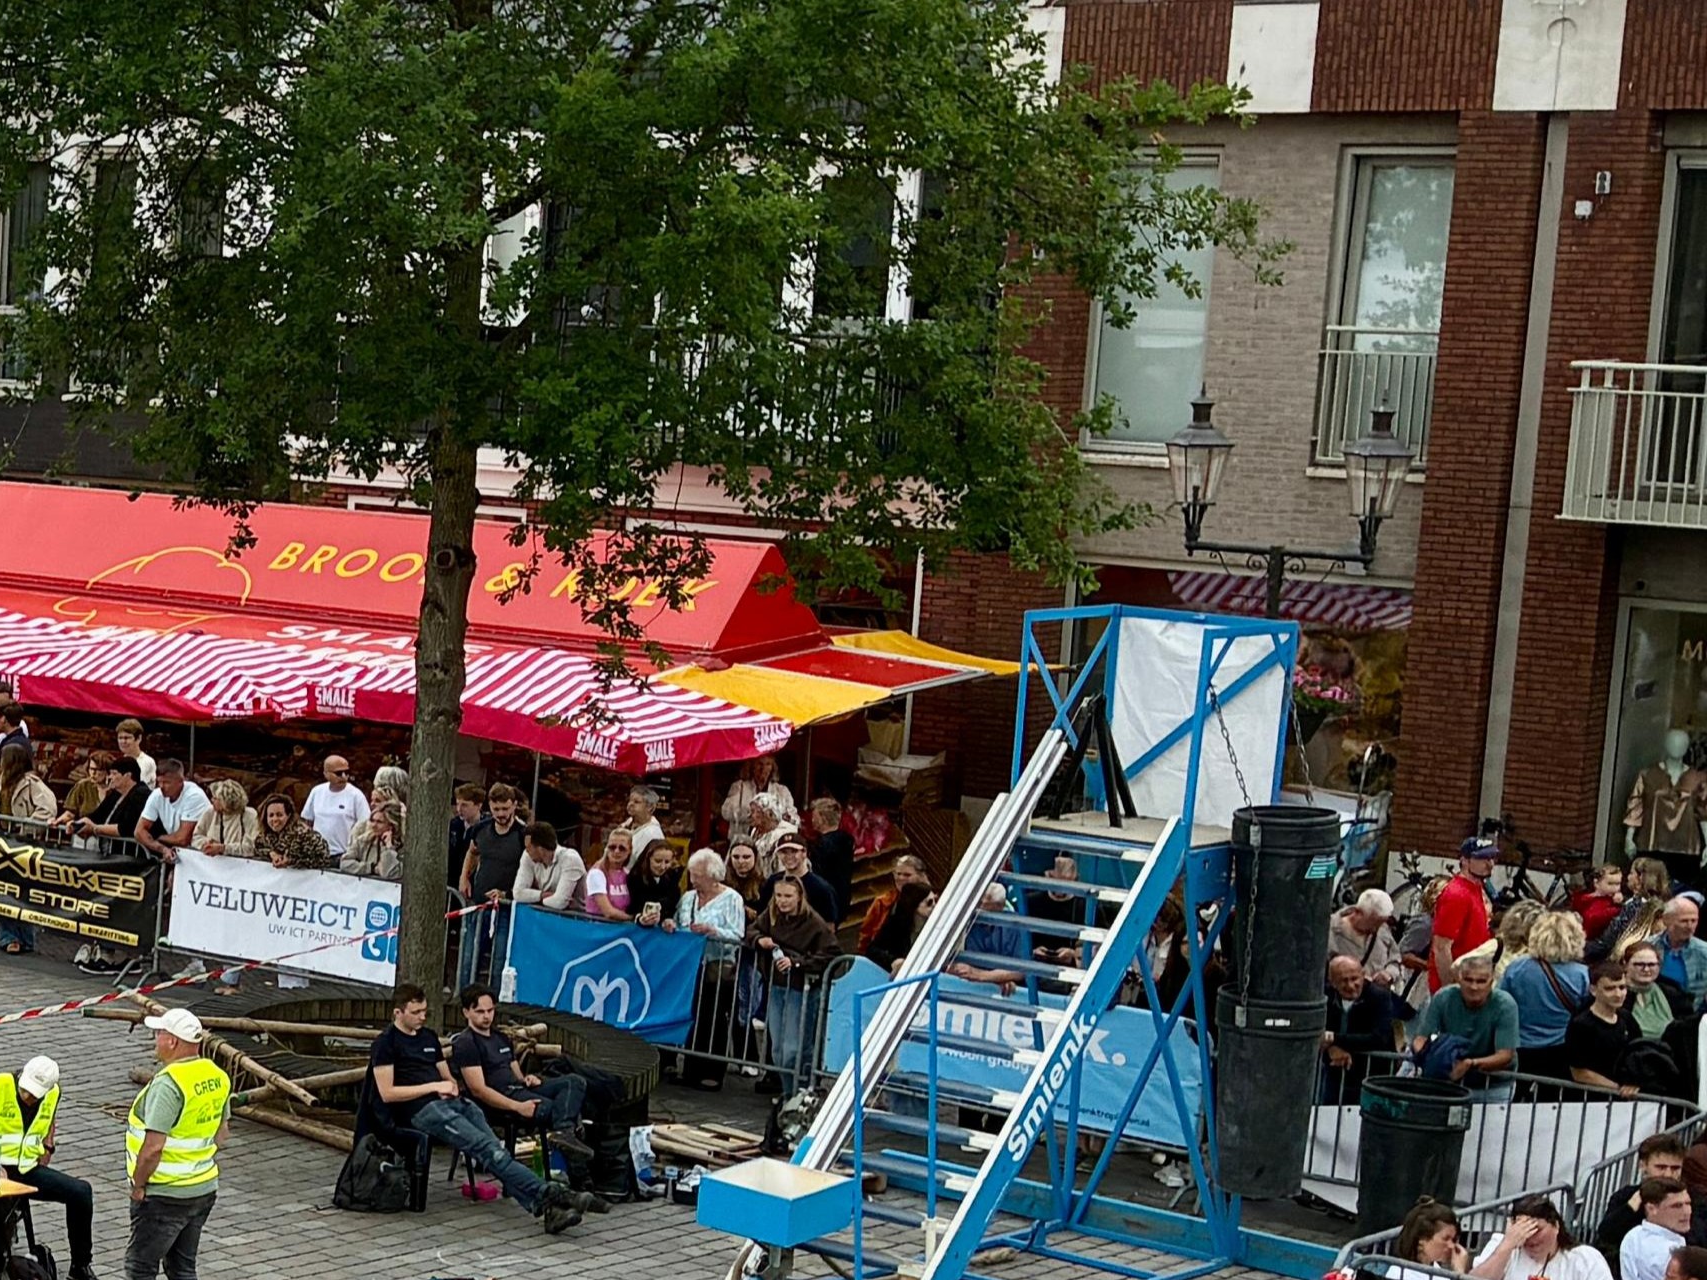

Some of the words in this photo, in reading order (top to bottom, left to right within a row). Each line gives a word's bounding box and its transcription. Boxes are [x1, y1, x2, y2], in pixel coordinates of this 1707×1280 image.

[268, 541, 427, 583] BROO
[314, 685, 356, 708] SMALE
[573, 729, 621, 757] SMALE
[643, 737, 676, 762] SMALE
[29, 888, 110, 919] STORE
[188, 878, 359, 931] VELUWEICT
[268, 922, 288, 935] UW
[289, 925, 305, 939] ICT
[193, 1078, 222, 1096] CREW
[1007, 1013, 1098, 1162] Smienk.
